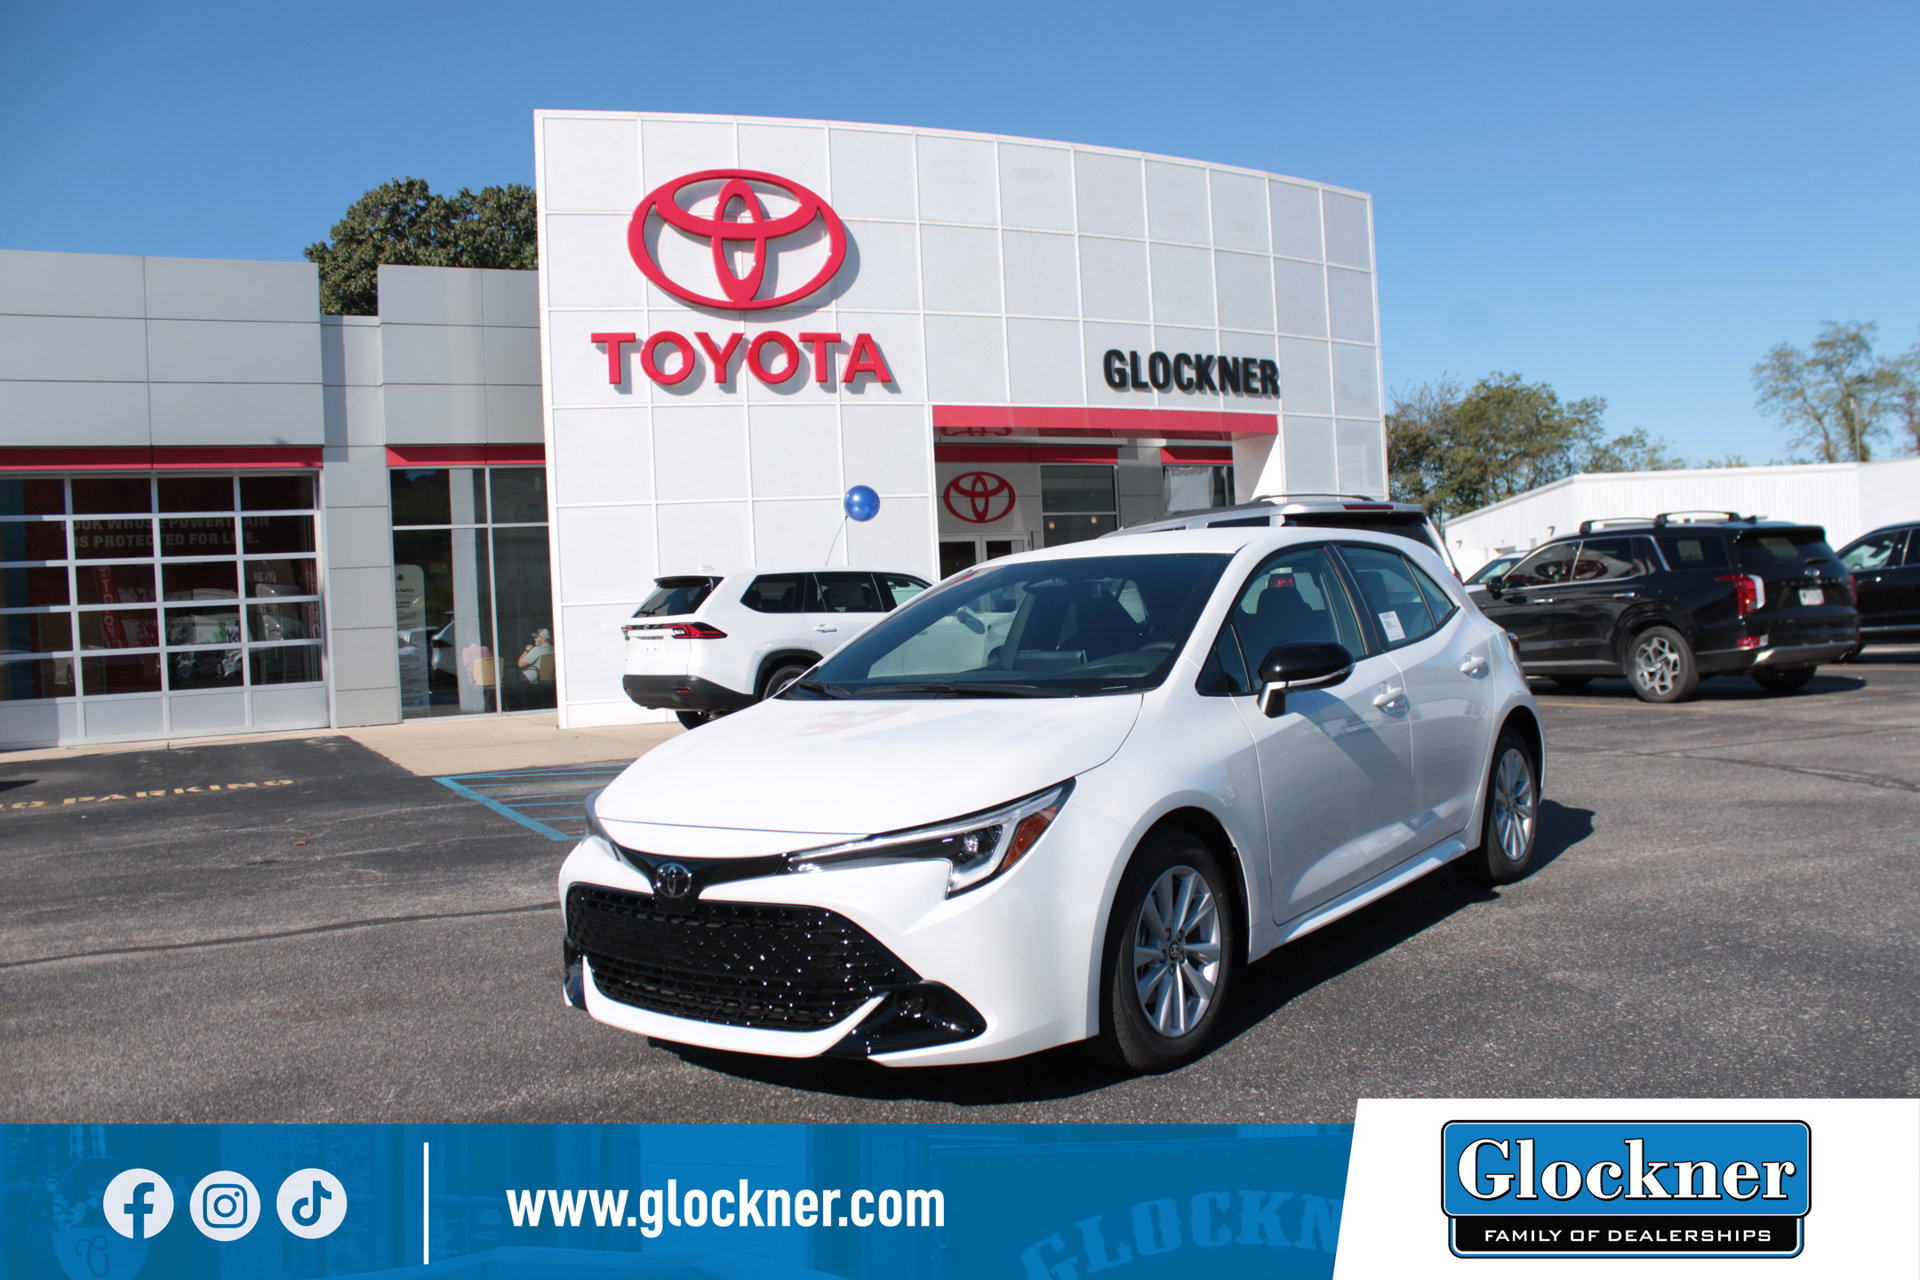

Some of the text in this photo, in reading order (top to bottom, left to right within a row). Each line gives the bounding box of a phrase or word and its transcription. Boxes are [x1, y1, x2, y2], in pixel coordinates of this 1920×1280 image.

[590, 330, 892, 385] TOYOTA
[1103, 348, 1281, 397] GLOCKNER
[169, 517, 270, 528] POWERTAIN
[189, 532, 218, 545] FOR
[222, 531, 260, 544] LIE.
[63, 779, 294, 805] PARKING
